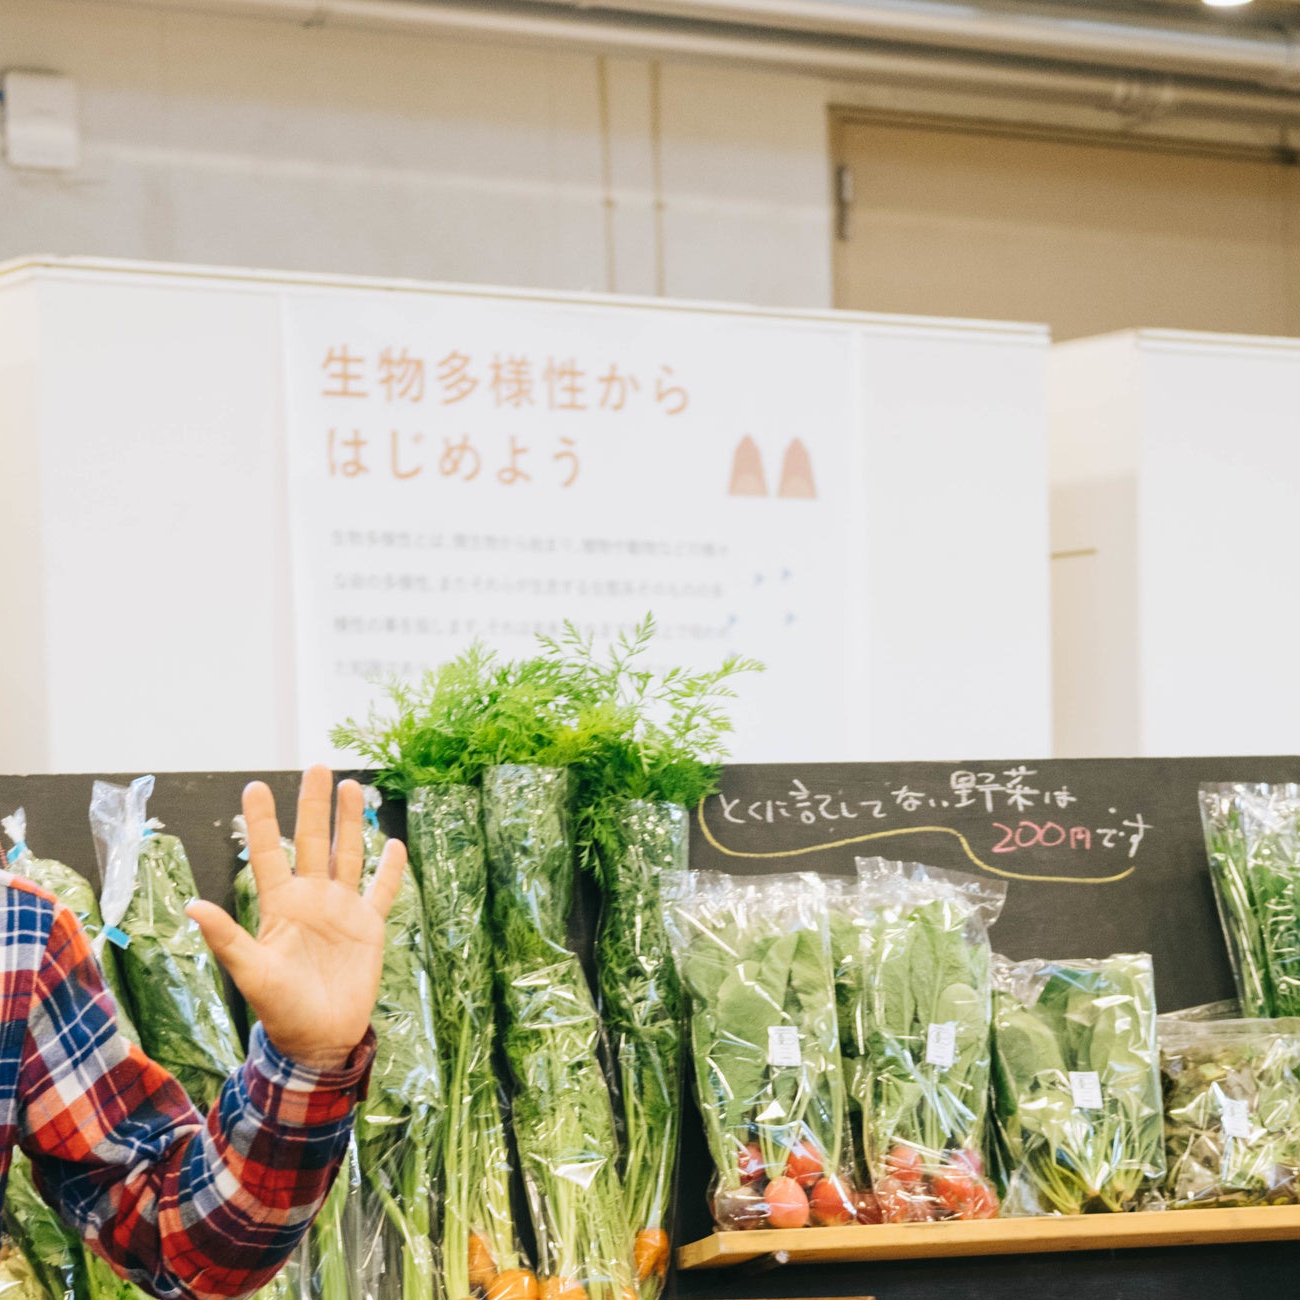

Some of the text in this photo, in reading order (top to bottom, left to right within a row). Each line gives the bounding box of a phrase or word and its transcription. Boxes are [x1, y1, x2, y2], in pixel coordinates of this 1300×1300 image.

[321, 344, 689, 415] 生物多様性から
[326, 426, 582, 488] はじめよう
